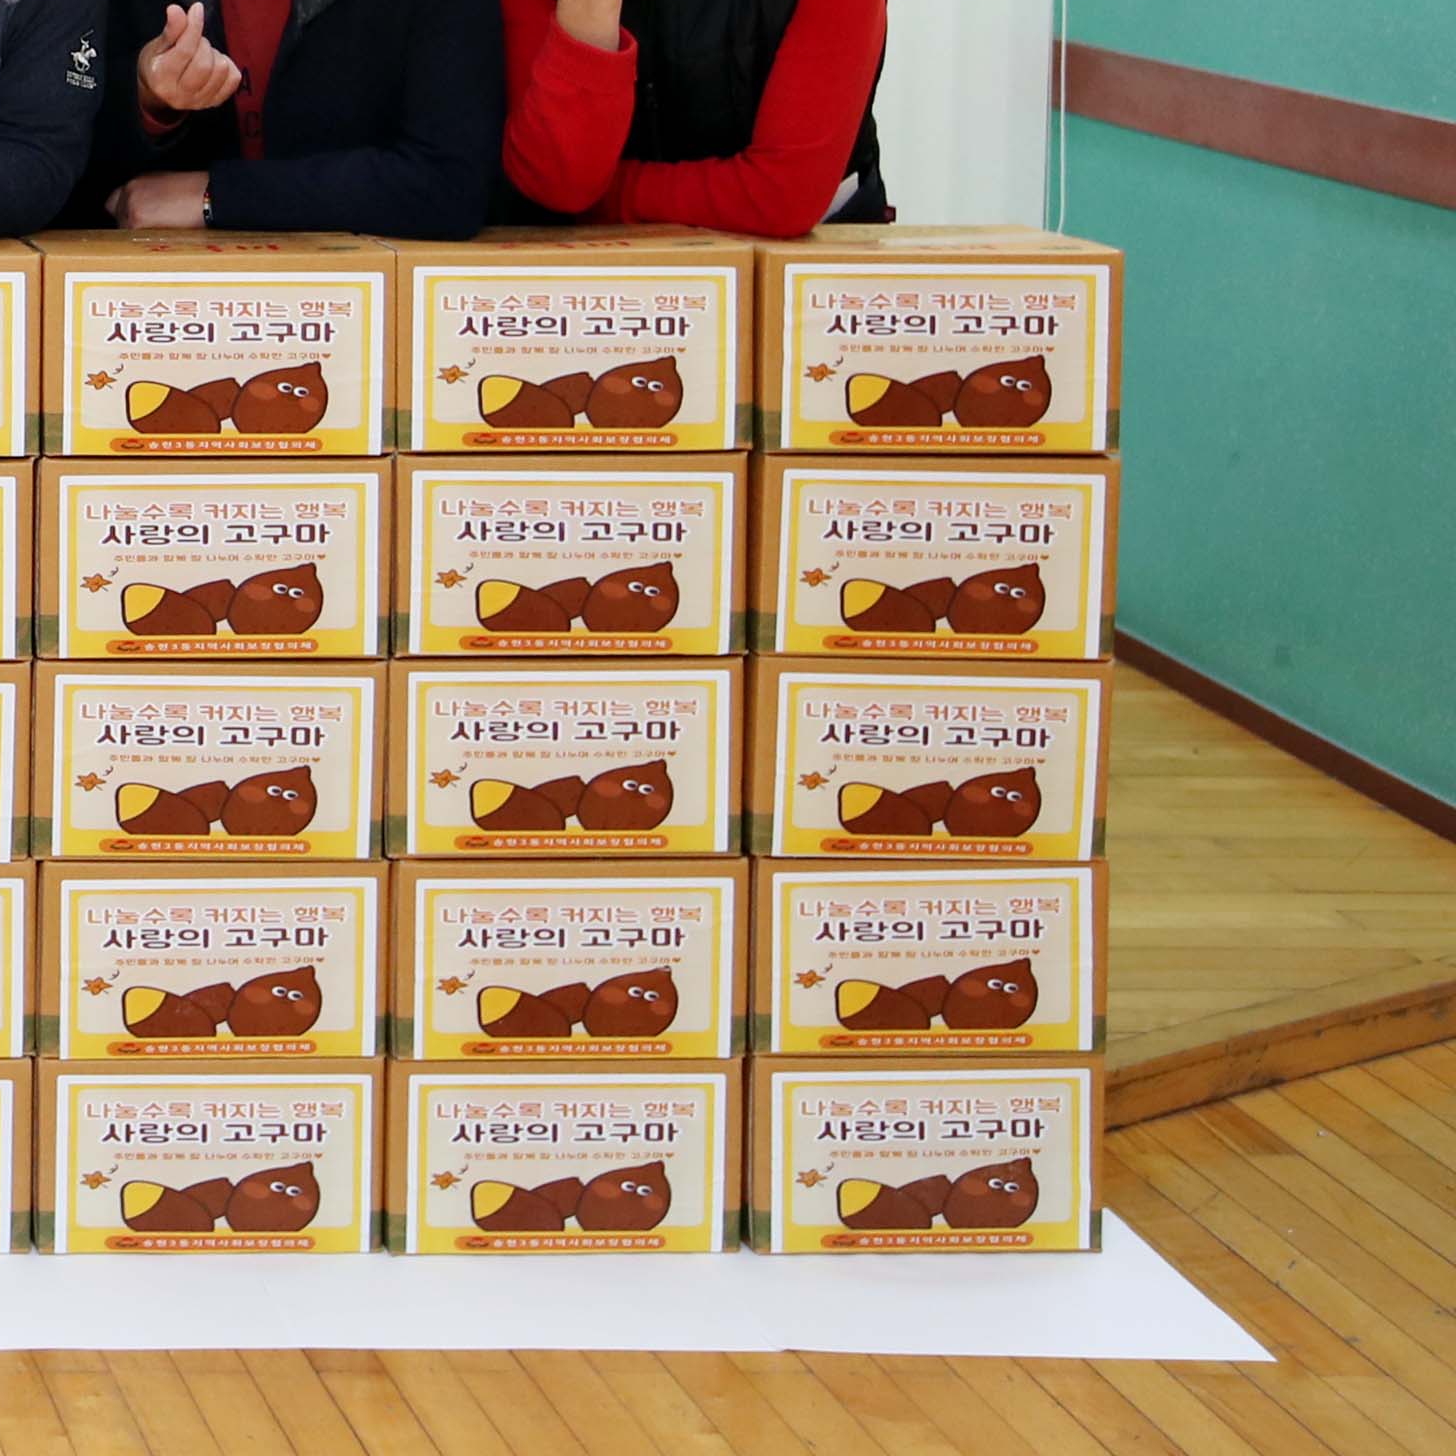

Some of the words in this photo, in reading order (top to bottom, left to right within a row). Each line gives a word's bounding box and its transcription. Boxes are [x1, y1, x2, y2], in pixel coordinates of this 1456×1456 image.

[107, 322, 214, 343] 사랑의
[230, 322, 336, 343] 고구마
[459, 315, 567, 337] 사랑의
[583, 315, 690, 337] 고구마
[827, 313, 936, 336] 사랑의
[952, 314, 1060, 336] 고구마
[102, 524, 209, 545] 사랑의
[225, 523, 330, 544] 고구마
[457, 520, 565, 542] 사랑의
[580, 521, 687, 543] 고구마
[823, 519, 933, 542] 사랑의
[947, 521, 1055, 545] 고구마
[97, 724, 204, 746] 사랑의
[219, 725, 326, 747] 고구마
[450, 721, 559, 741] 사랑의
[574, 720, 681, 741] 고구마
[820, 722, 929, 746] 사랑의
[944, 725, 1051, 749] 고구마
[103, 928, 209, 949] 사랑의
[224, 927, 329, 948] 고구마
[458, 928, 565, 948] 사랑의
[580, 927, 686, 948] 고구마
[816, 920, 923, 942] 사랑의
[939, 919, 1045, 940] 고구마
[87, 1102, 191, 1119] 나눌수록
[203, 1102, 281, 1119] 커지는
[292, 1103, 344, 1119] 행복
[102, 1123, 208, 1143] 사랑의
[223, 1122, 328, 1143] 고구마
[452, 1123, 559, 1143] 사랑의
[574, 1122, 679, 1143] 고구마
[817, 1120, 925, 1141] 사랑의
[940, 1118, 1046, 1140] 고구마
